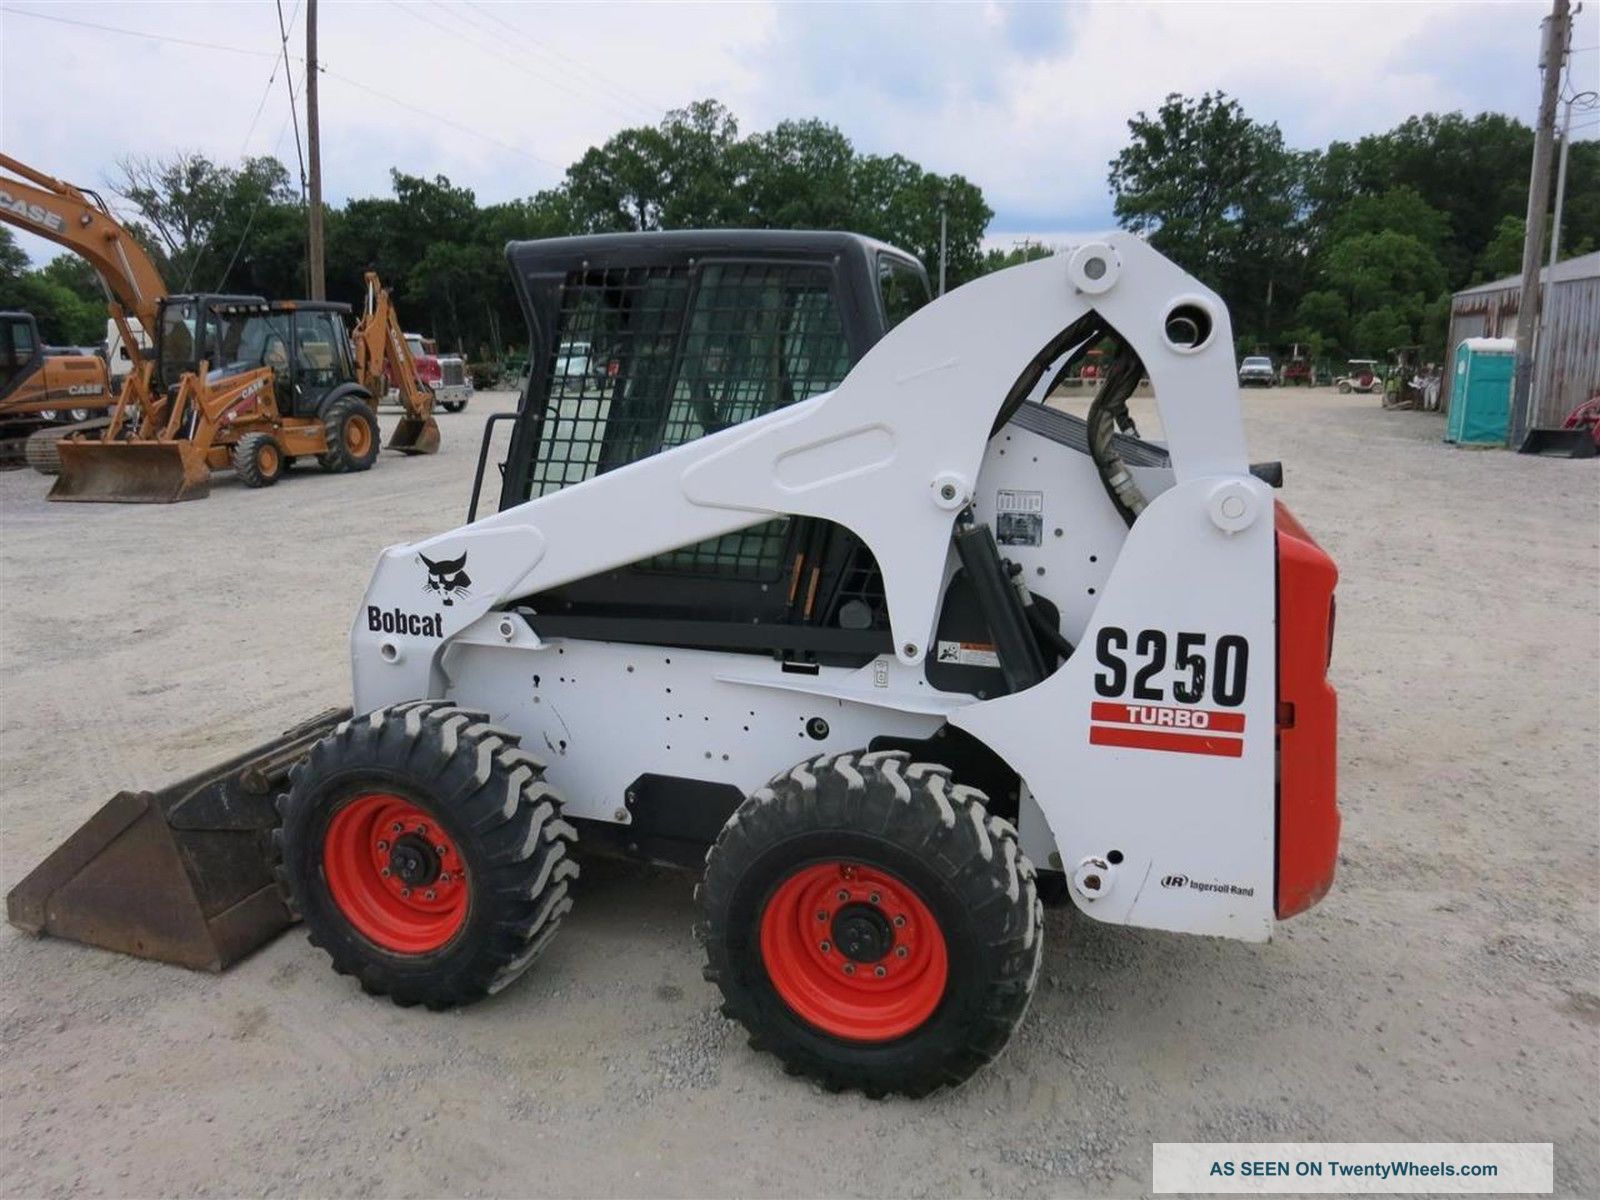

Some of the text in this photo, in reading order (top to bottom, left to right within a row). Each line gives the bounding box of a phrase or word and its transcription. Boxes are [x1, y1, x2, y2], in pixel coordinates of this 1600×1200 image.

[0, 191, 62, 229] CASE
[69, 384, 102, 395] CASE
[241, 379, 264, 399] CASE
[368, 605, 443, 638] Bobcat
[1094, 626, 1249, 707] S250
[1126, 705, 1209, 729] TURBO
